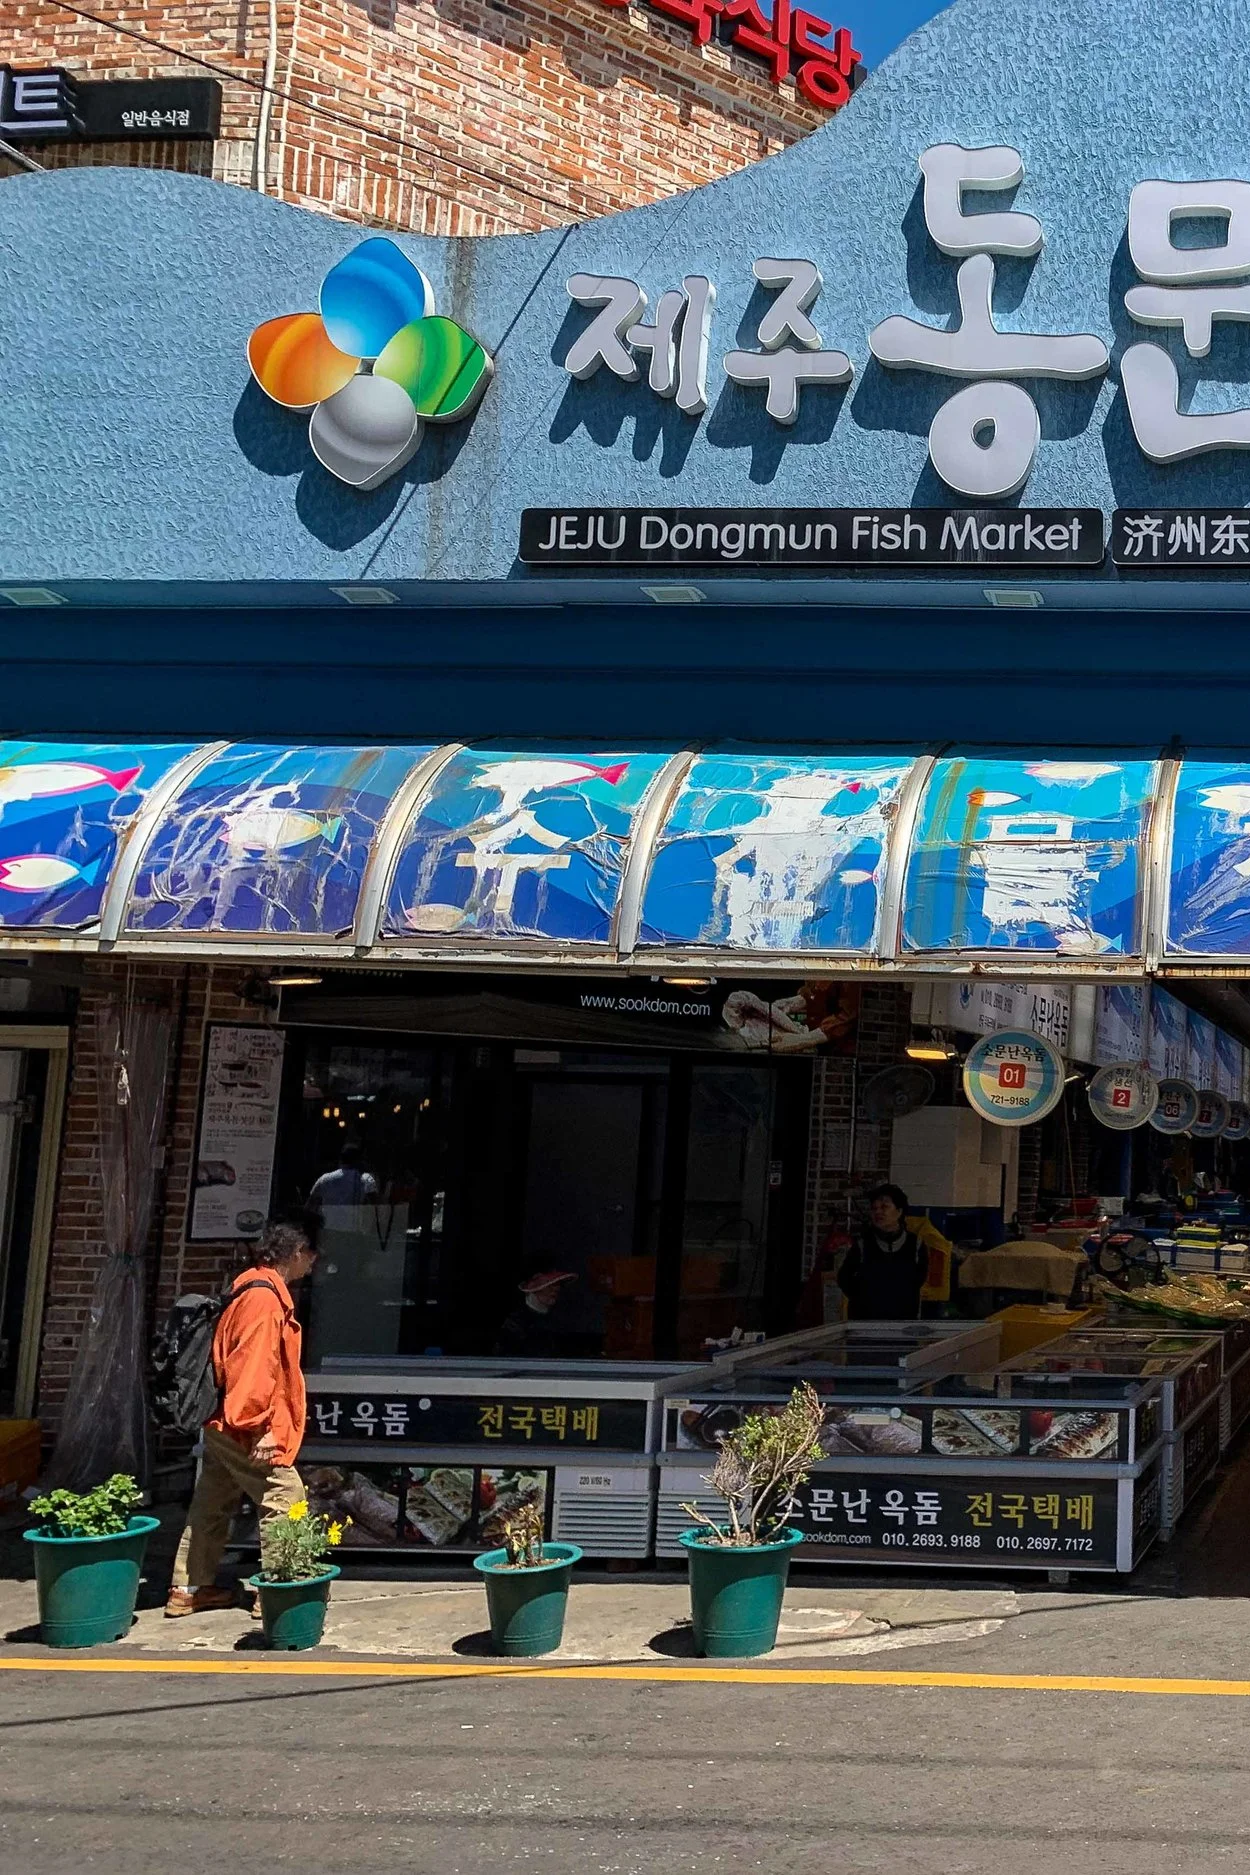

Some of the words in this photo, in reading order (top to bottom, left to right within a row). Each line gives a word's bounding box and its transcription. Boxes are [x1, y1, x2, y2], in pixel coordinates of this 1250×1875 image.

[121, 109, 190, 127] 일반음식점
[565, 262, 853, 425] 제주
[538, 516, 625, 550] JEJU
[640, 515, 838, 558] Dongmun
[851, 515, 926, 551] Fish
[940, 514, 1083, 551] Market
[580, 994, 711, 1017] www.sookdom.com
[980, 1043, 1047, 1062] 소문난옥돔
[1003, 1067, 1020, 1084] 01
[1116, 1092, 1126, 1104] 2
[477, 1404, 599, 1441] 전국택배
[965, 1492, 1094, 1530] 전국택배
